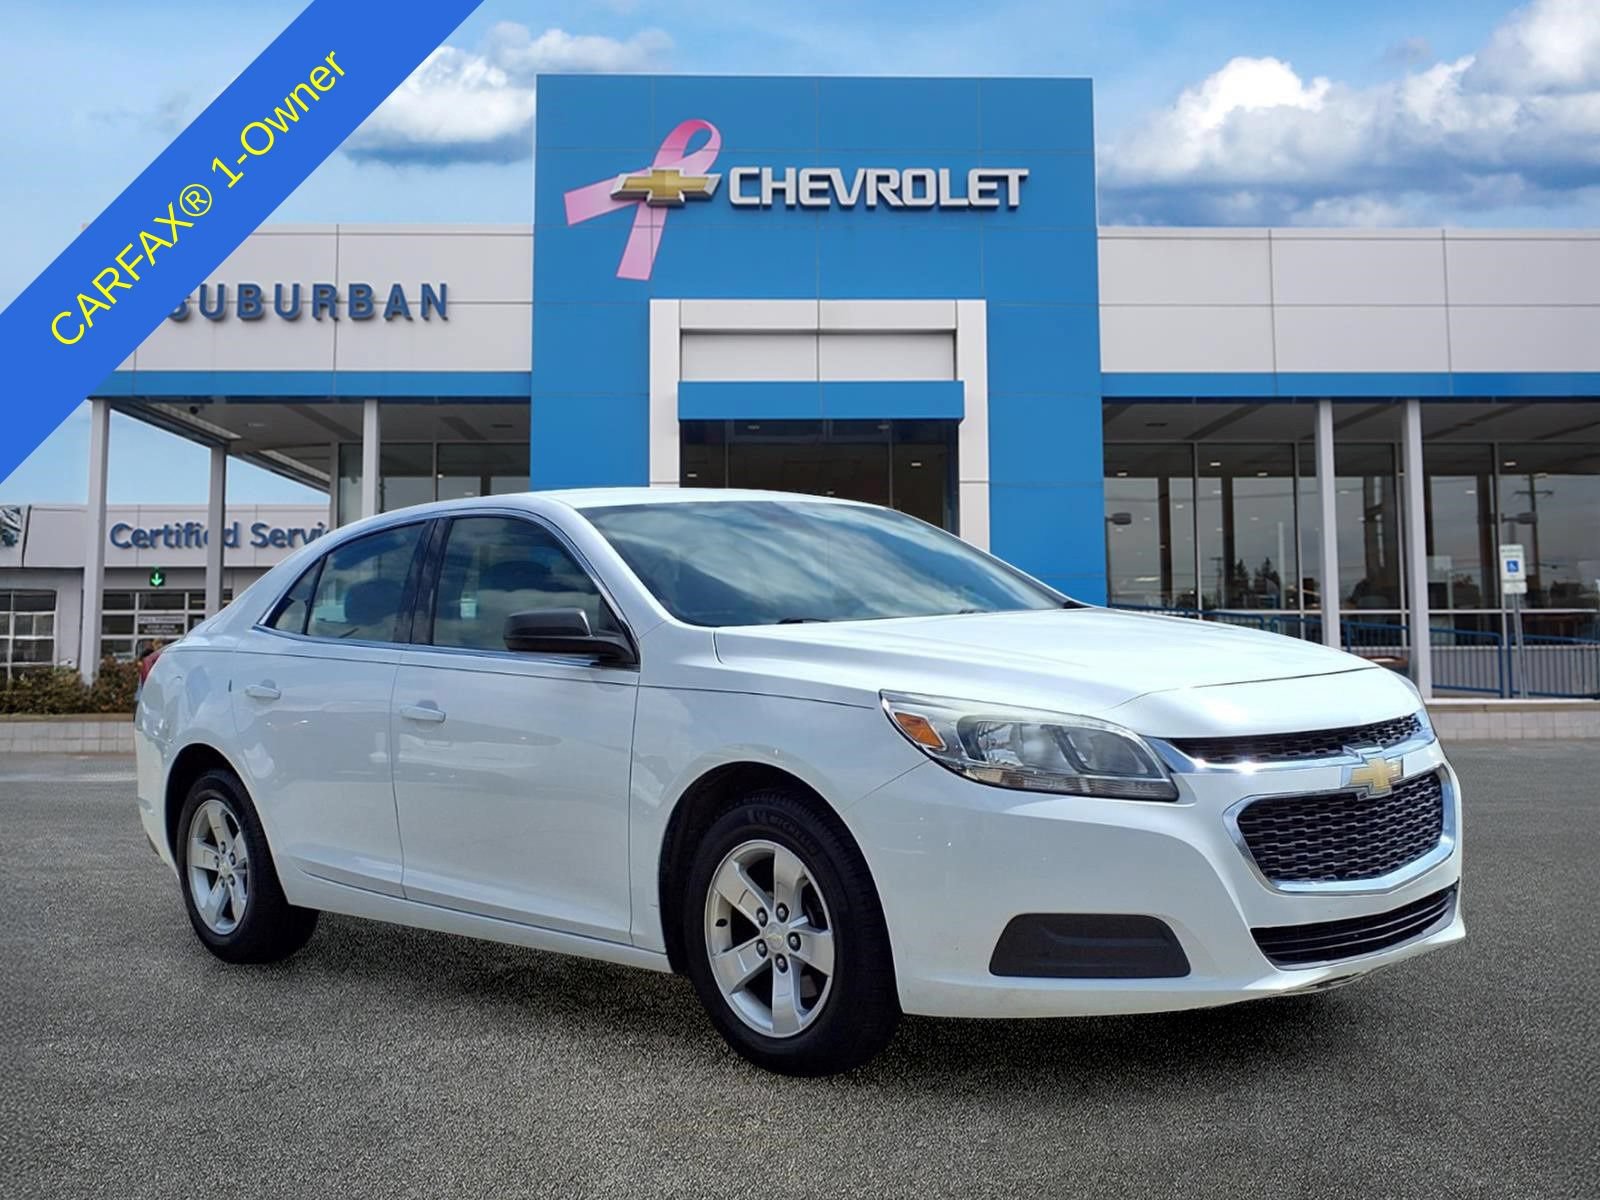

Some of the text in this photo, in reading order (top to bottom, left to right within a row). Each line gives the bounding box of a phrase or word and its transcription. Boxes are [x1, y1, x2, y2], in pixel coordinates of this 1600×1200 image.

[729, 167, 1029, 209] CHEVROLET
[109, 521, 330, 549] Certifid Servi
